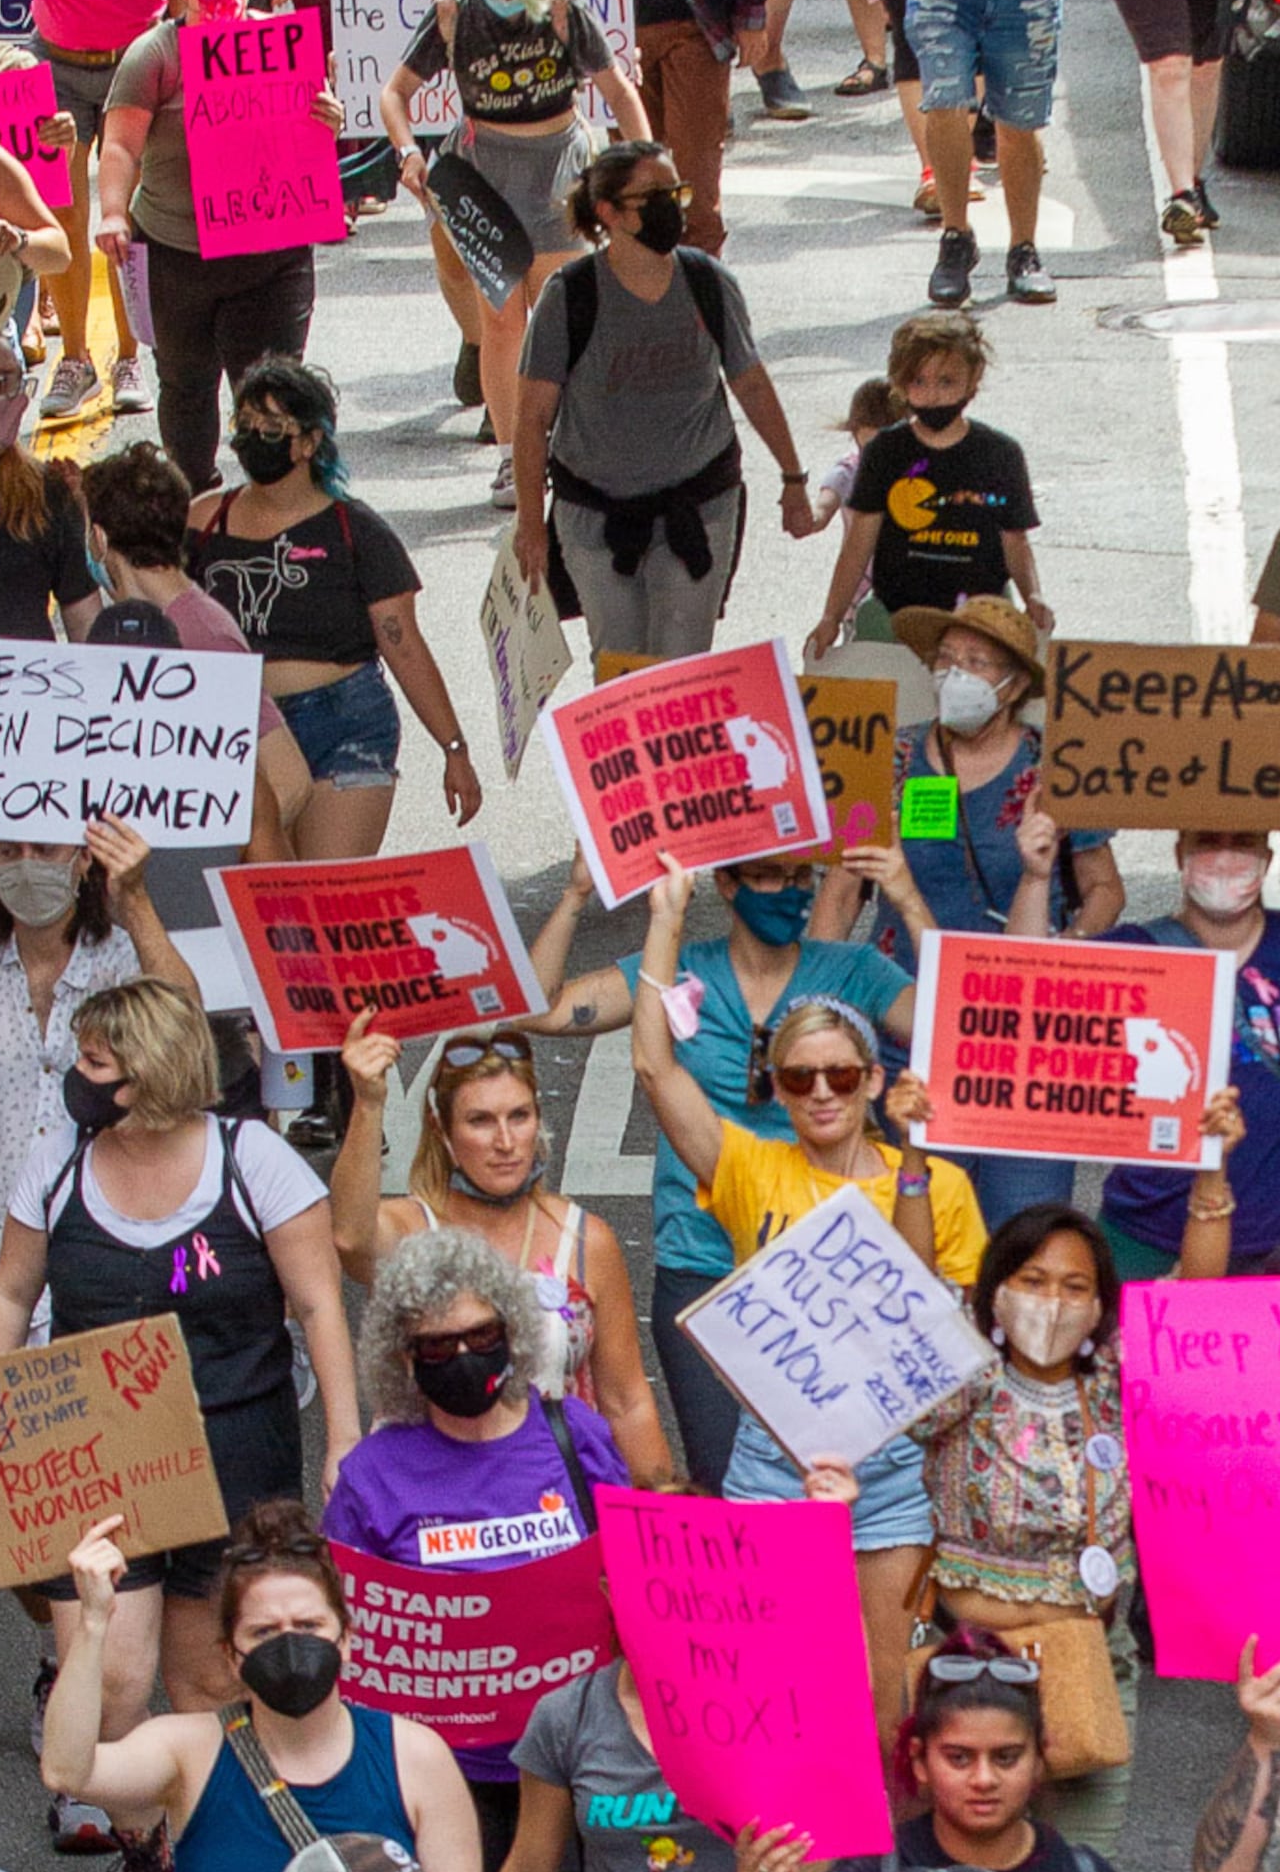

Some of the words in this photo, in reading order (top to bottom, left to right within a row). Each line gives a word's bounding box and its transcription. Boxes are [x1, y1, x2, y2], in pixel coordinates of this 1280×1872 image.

[112, 655, 196, 704] NO
[1053, 646, 1199, 721] Keep
[54, 714, 252, 764] DECIDING
[1050, 737, 1172, 798] Safe
[81, 778, 241, 830] WOMEN
[962, 971, 1023, 1006] OUR
[1033, 977, 1147, 1014] RIGHTS
[959, 1007, 1020, 1040] OUR
[1032, 1012, 1122, 1048] VOICE
[956, 1041, 1018, 1075] OUR
[1028, 1047, 1139, 1084] POWER
[953, 1075, 1015, 1109] OUR
[1025, 1081, 1144, 1120] CHOICE.
[343, 1573, 355, 1597] I
[364, 1581, 491, 1618] STAND
[348, 1604, 443, 1645] WITH
[340, 1649, 596, 1699] PARENTHOOD
[349, 1634, 517, 1672] PLANNED
